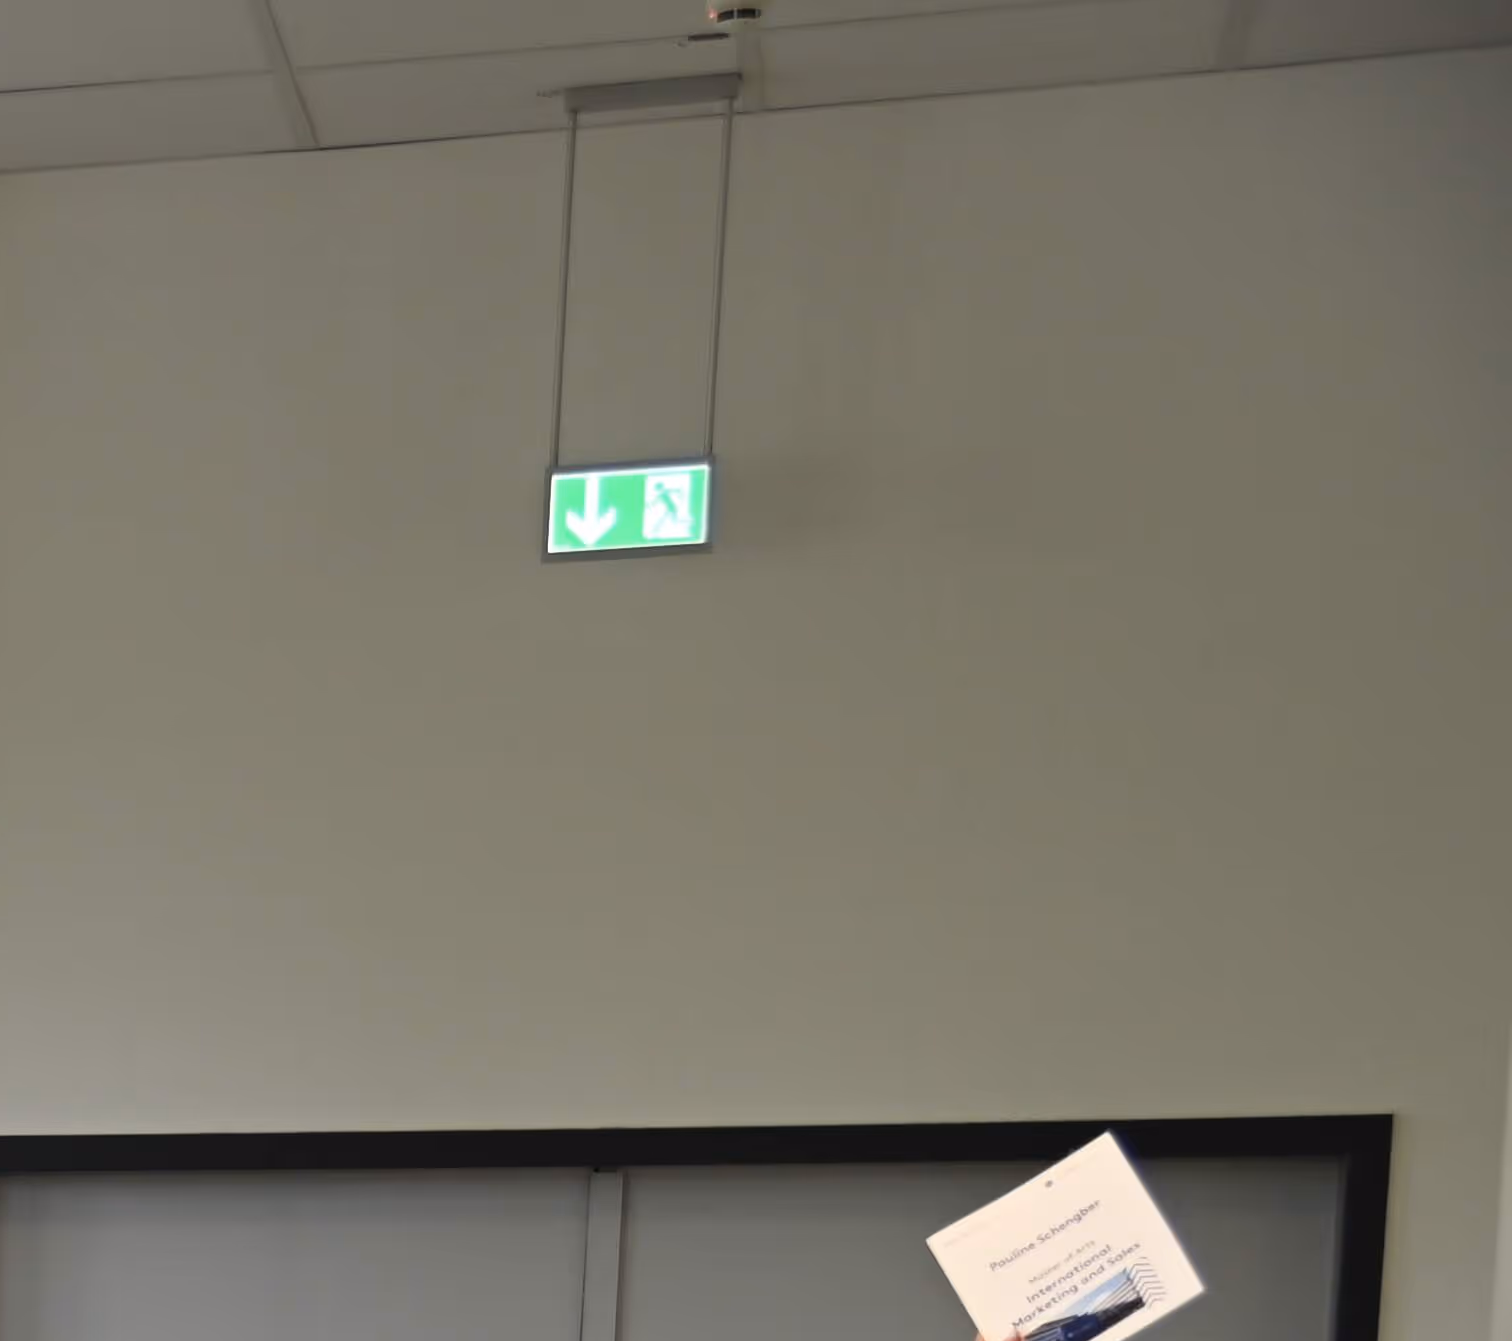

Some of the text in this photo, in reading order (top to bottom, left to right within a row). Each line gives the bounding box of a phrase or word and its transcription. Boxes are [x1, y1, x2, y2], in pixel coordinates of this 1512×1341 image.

[989, 1241, 1036, 1273] Pauline
[1012, 1242, 1141, 1328] Marketing and Sales
[1026, 1244, 1112, 1304] International
